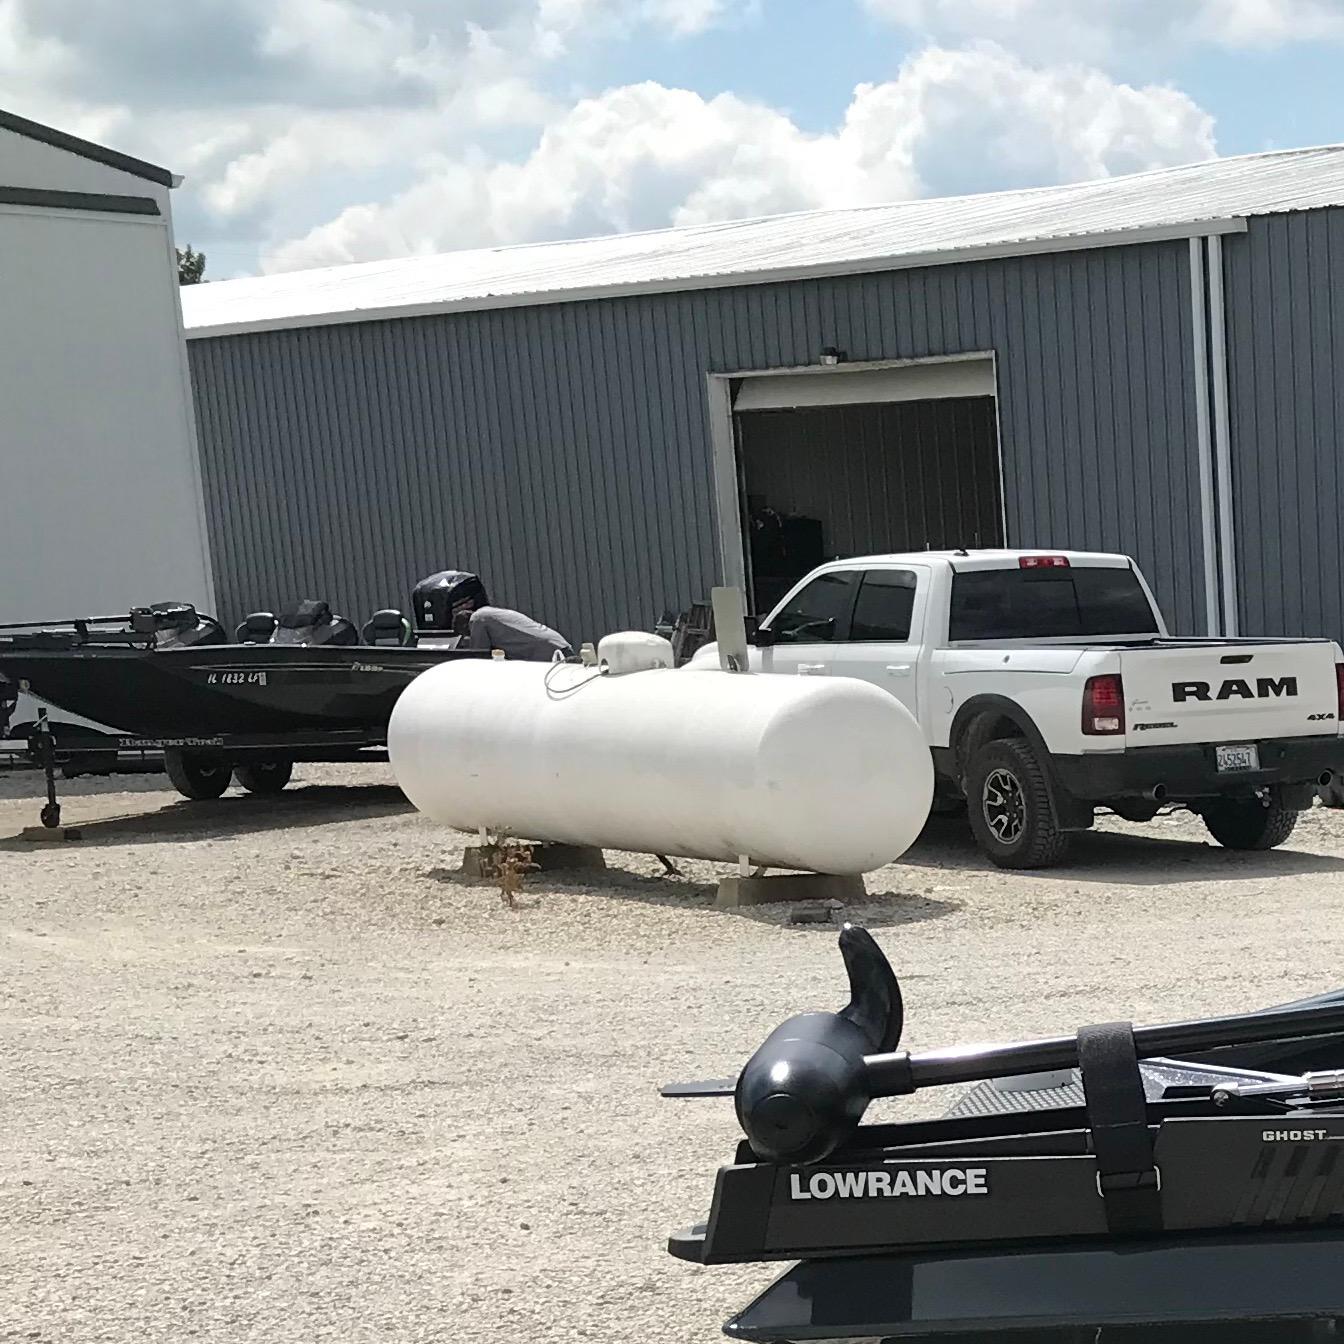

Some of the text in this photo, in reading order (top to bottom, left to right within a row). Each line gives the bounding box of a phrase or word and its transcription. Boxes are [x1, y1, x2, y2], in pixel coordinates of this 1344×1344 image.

[1171, 676, 1298, 702] RAM
[1307, 712, 1335, 721] 4X4
[1262, 1129, 1327, 1141] GHOST
[790, 1168, 988, 1200] LOWRANCE
